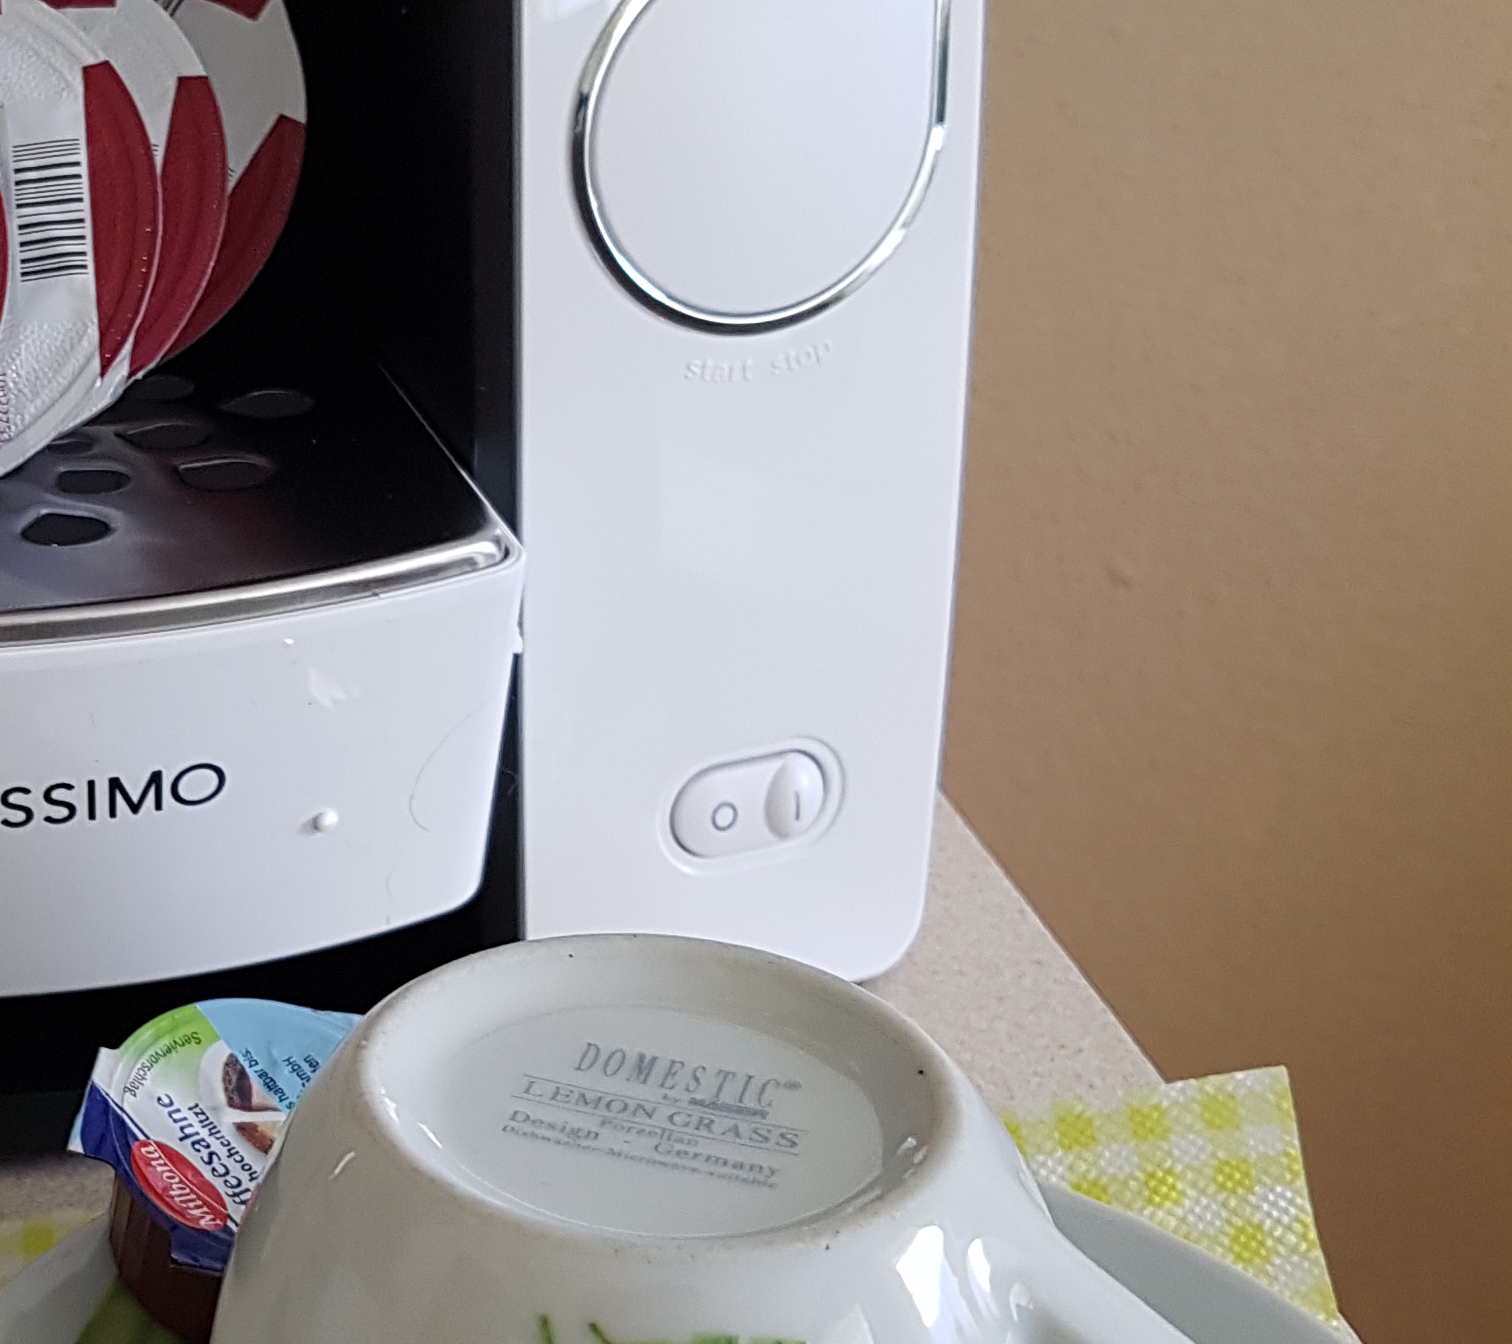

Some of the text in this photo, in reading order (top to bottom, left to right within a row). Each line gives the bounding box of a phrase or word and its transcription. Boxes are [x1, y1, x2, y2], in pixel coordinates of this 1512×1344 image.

[574, 1041, 780, 1109] DOMESTIC
[508, 1109, 600, 1141] Design
[653, 1141, 781, 1178] Germany
[522, 1080, 658, 1120] LEMON
[667, 1109, 800, 1150] GRASS
[139, 1143, 223, 1229] Milbona
